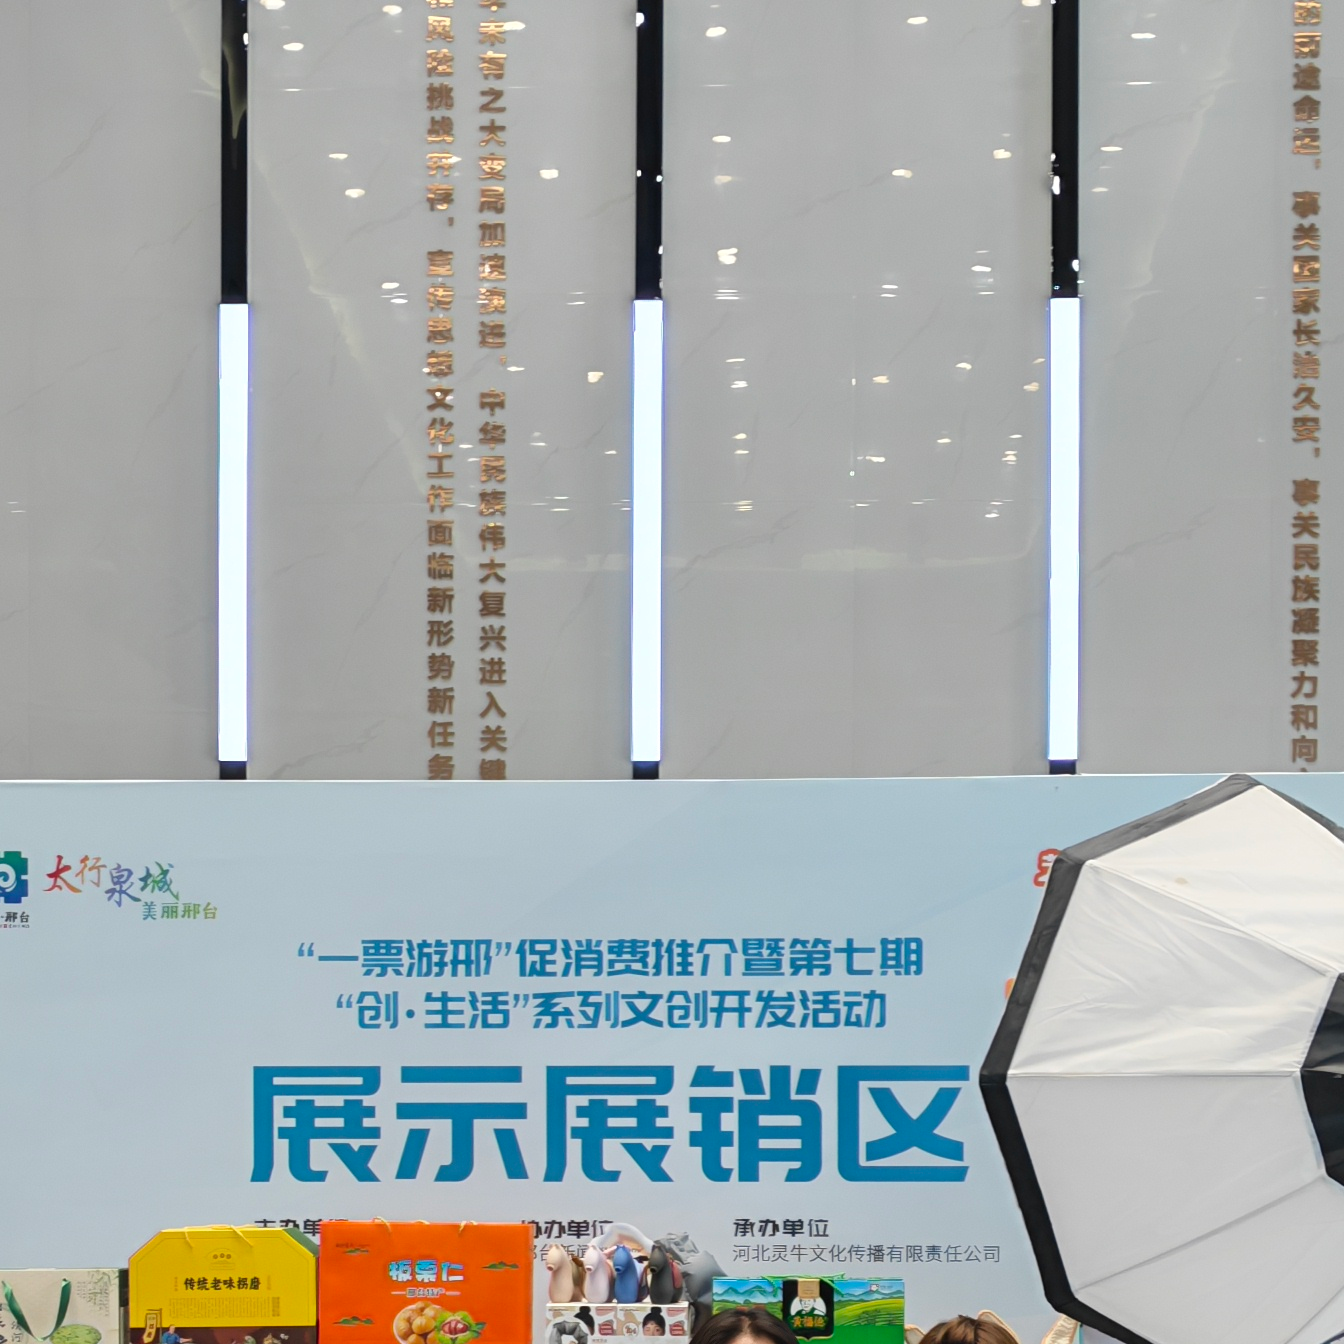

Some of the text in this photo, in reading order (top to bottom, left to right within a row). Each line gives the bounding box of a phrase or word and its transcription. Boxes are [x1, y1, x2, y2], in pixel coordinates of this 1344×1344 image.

[426, 0, 455, 780] 风险挑战并存，宣传思想文化工作面临新形势新任务
[1291, 1, 1322, 772] 的前途命运，事关国家长治久安，事关民族凝聚力和向
[43, 855, 180, 908] 太行泉城
[142, 902, 218, 920] 美丽邢台
[250, 1065, 970, 1182] 展示展销区
[732, 1244, 1002, 1264] 河北灵牛文化传播有限责任公司
[733, 1219, 830, 1238] 承办单位
